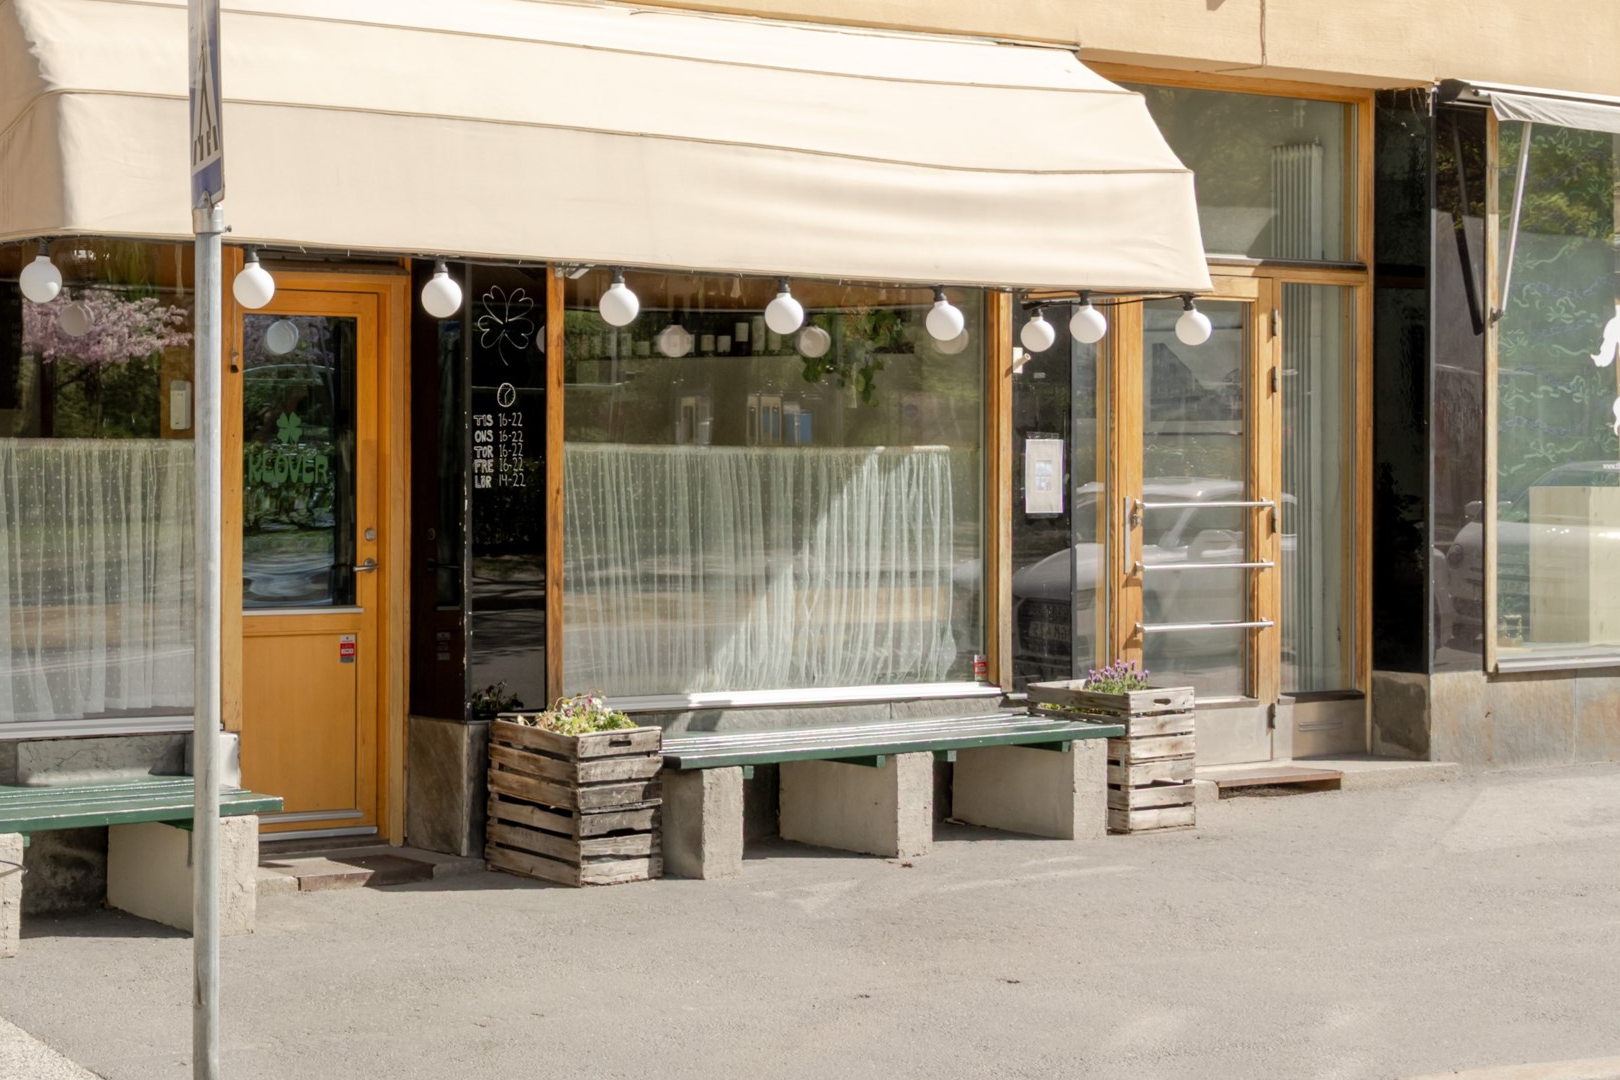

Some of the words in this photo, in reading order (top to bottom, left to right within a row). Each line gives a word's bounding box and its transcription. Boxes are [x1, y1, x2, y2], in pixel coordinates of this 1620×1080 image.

[473, 414, 494, 426] TIS
[498, 412, 523, 427] 16-22
[474, 429, 494, 442] ONS
[499, 430, 524, 442] 16-22
[473, 445, 494, 458] TOR
[499, 442, 524, 458] 16-22
[473, 459, 494, 473] FRE
[499, 457, 524, 472] 16-22
[499, 472, 526, 487] 14-22
